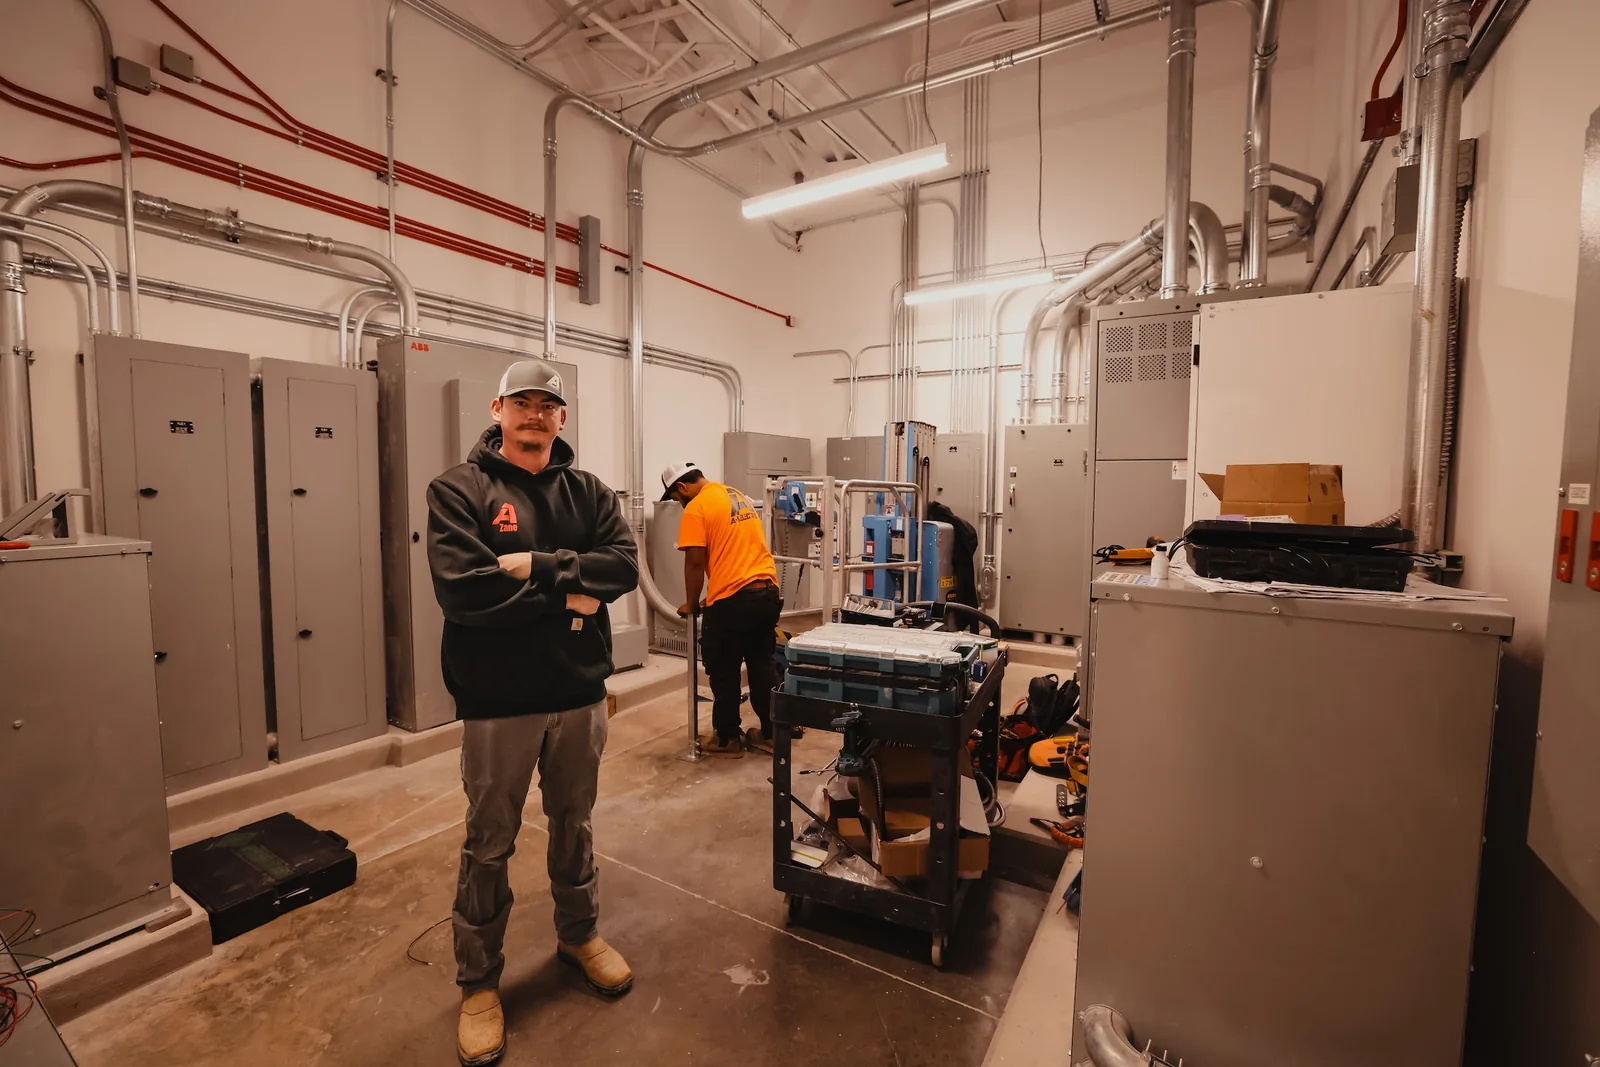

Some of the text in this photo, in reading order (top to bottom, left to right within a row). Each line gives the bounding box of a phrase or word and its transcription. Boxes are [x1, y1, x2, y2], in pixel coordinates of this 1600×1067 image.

[410, 341, 430, 352] ABB
[491, 502, 518, 525] A
[499, 523, 518, 533] Zane
